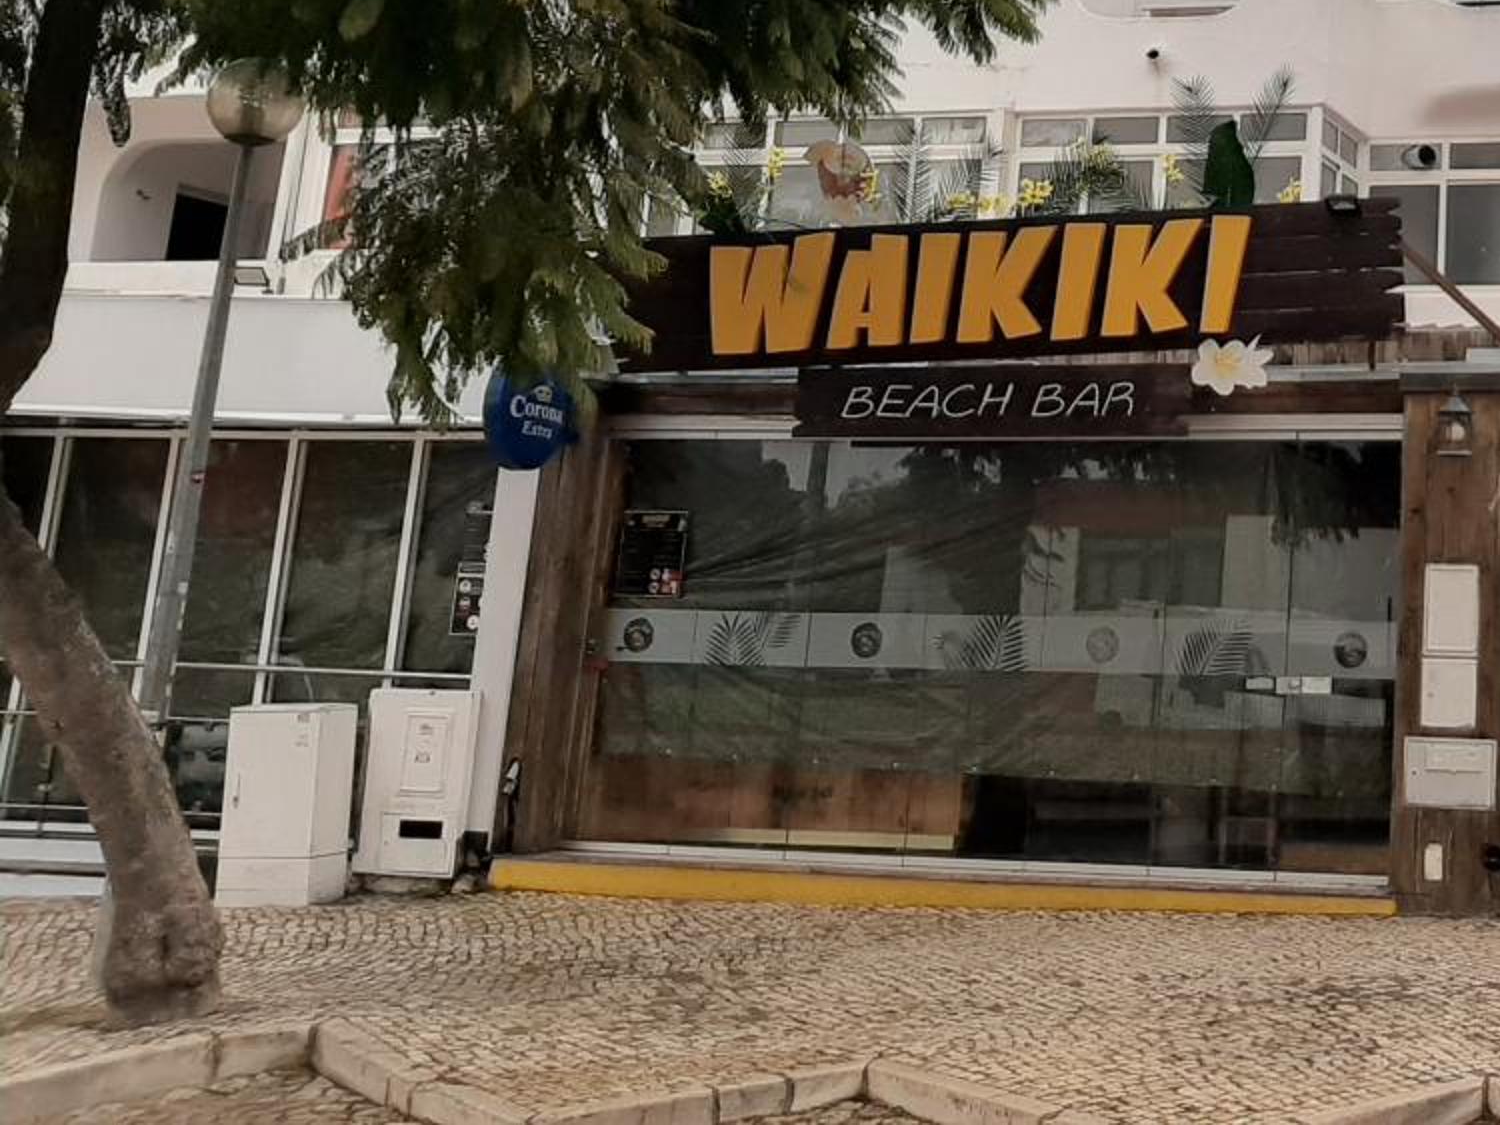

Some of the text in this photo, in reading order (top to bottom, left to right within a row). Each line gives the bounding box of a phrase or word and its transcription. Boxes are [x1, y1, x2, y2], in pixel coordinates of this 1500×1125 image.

[709, 215, 1253, 355] WAIKIKI
[510, 395, 563, 424] Corona
[840, 381, 1136, 419] BEACH BAR
[521, 420, 553, 440] Extra
